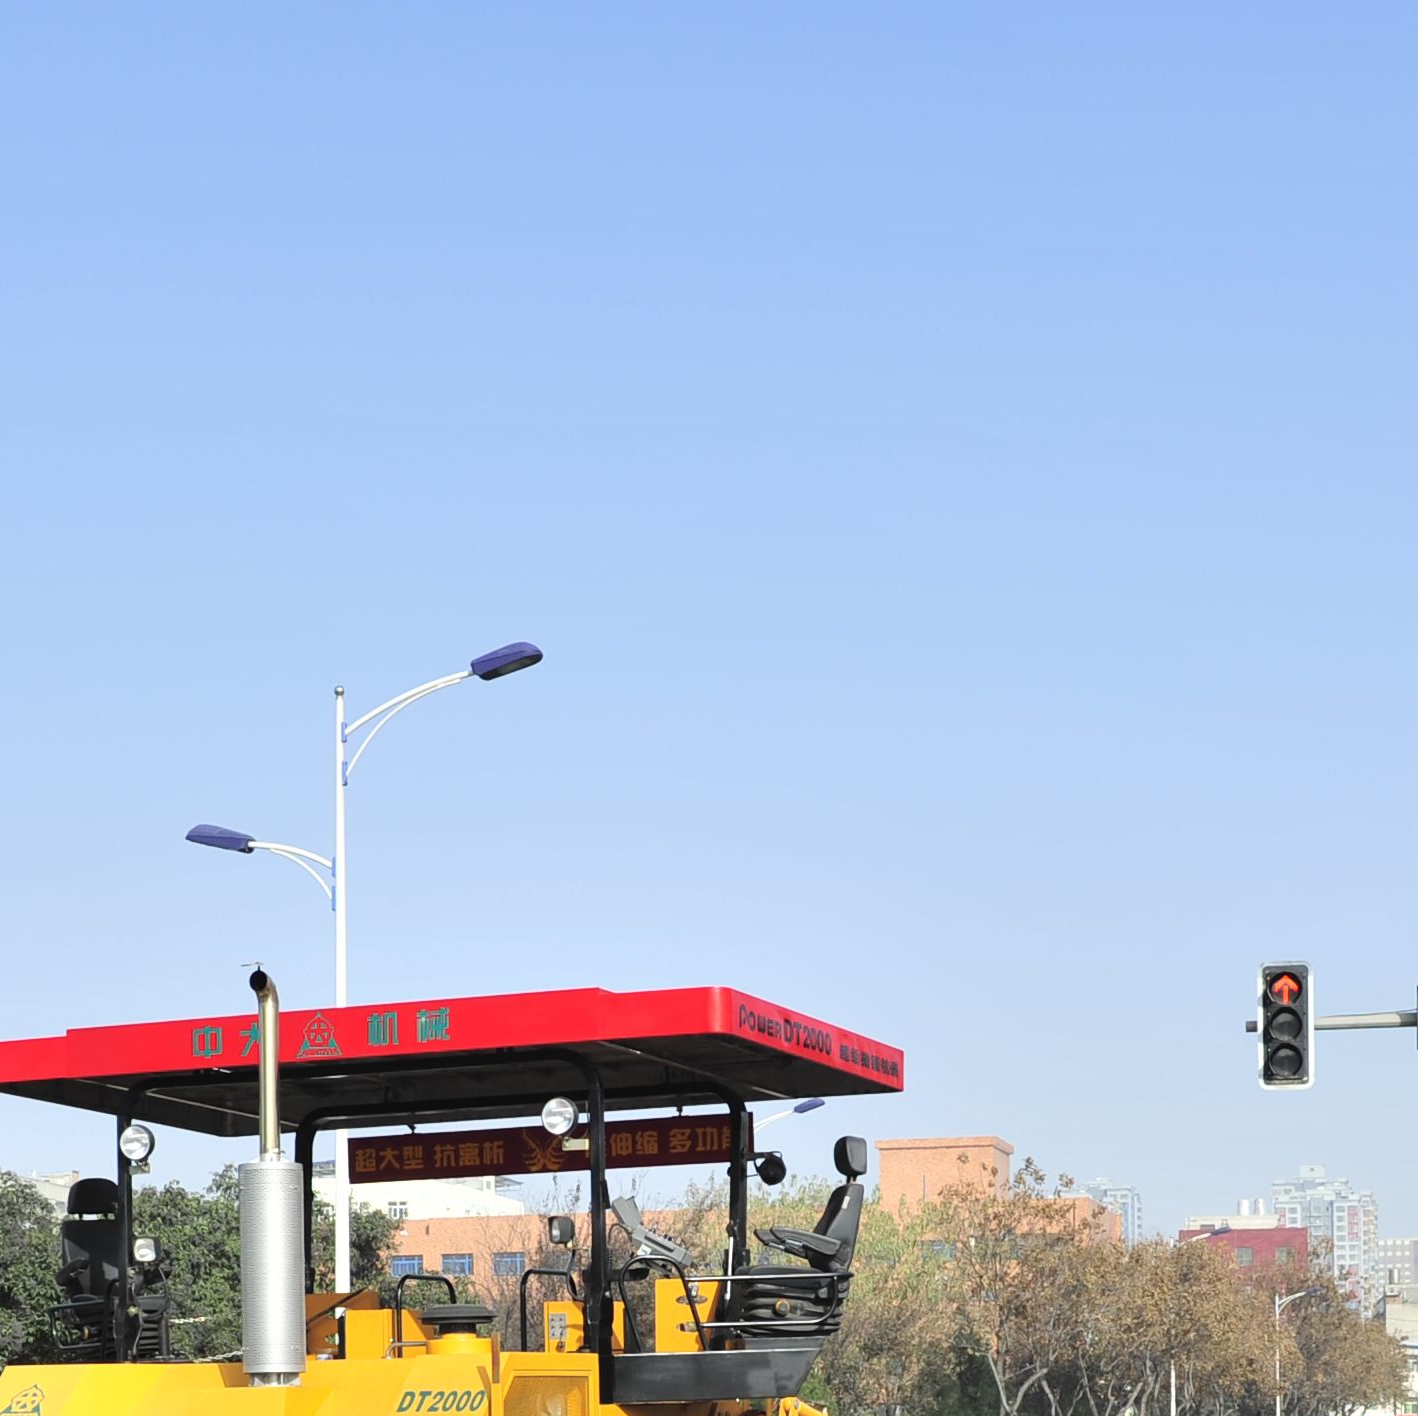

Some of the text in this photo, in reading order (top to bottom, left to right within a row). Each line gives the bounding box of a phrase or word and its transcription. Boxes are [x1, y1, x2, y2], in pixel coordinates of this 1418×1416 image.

[367, 1007, 450, 1046] 机械
[355, 1148, 424, 1173] 超大型
[434, 1140, 504, 1168] 抗离析
[396, 1390, 486, 1412] DT2000
